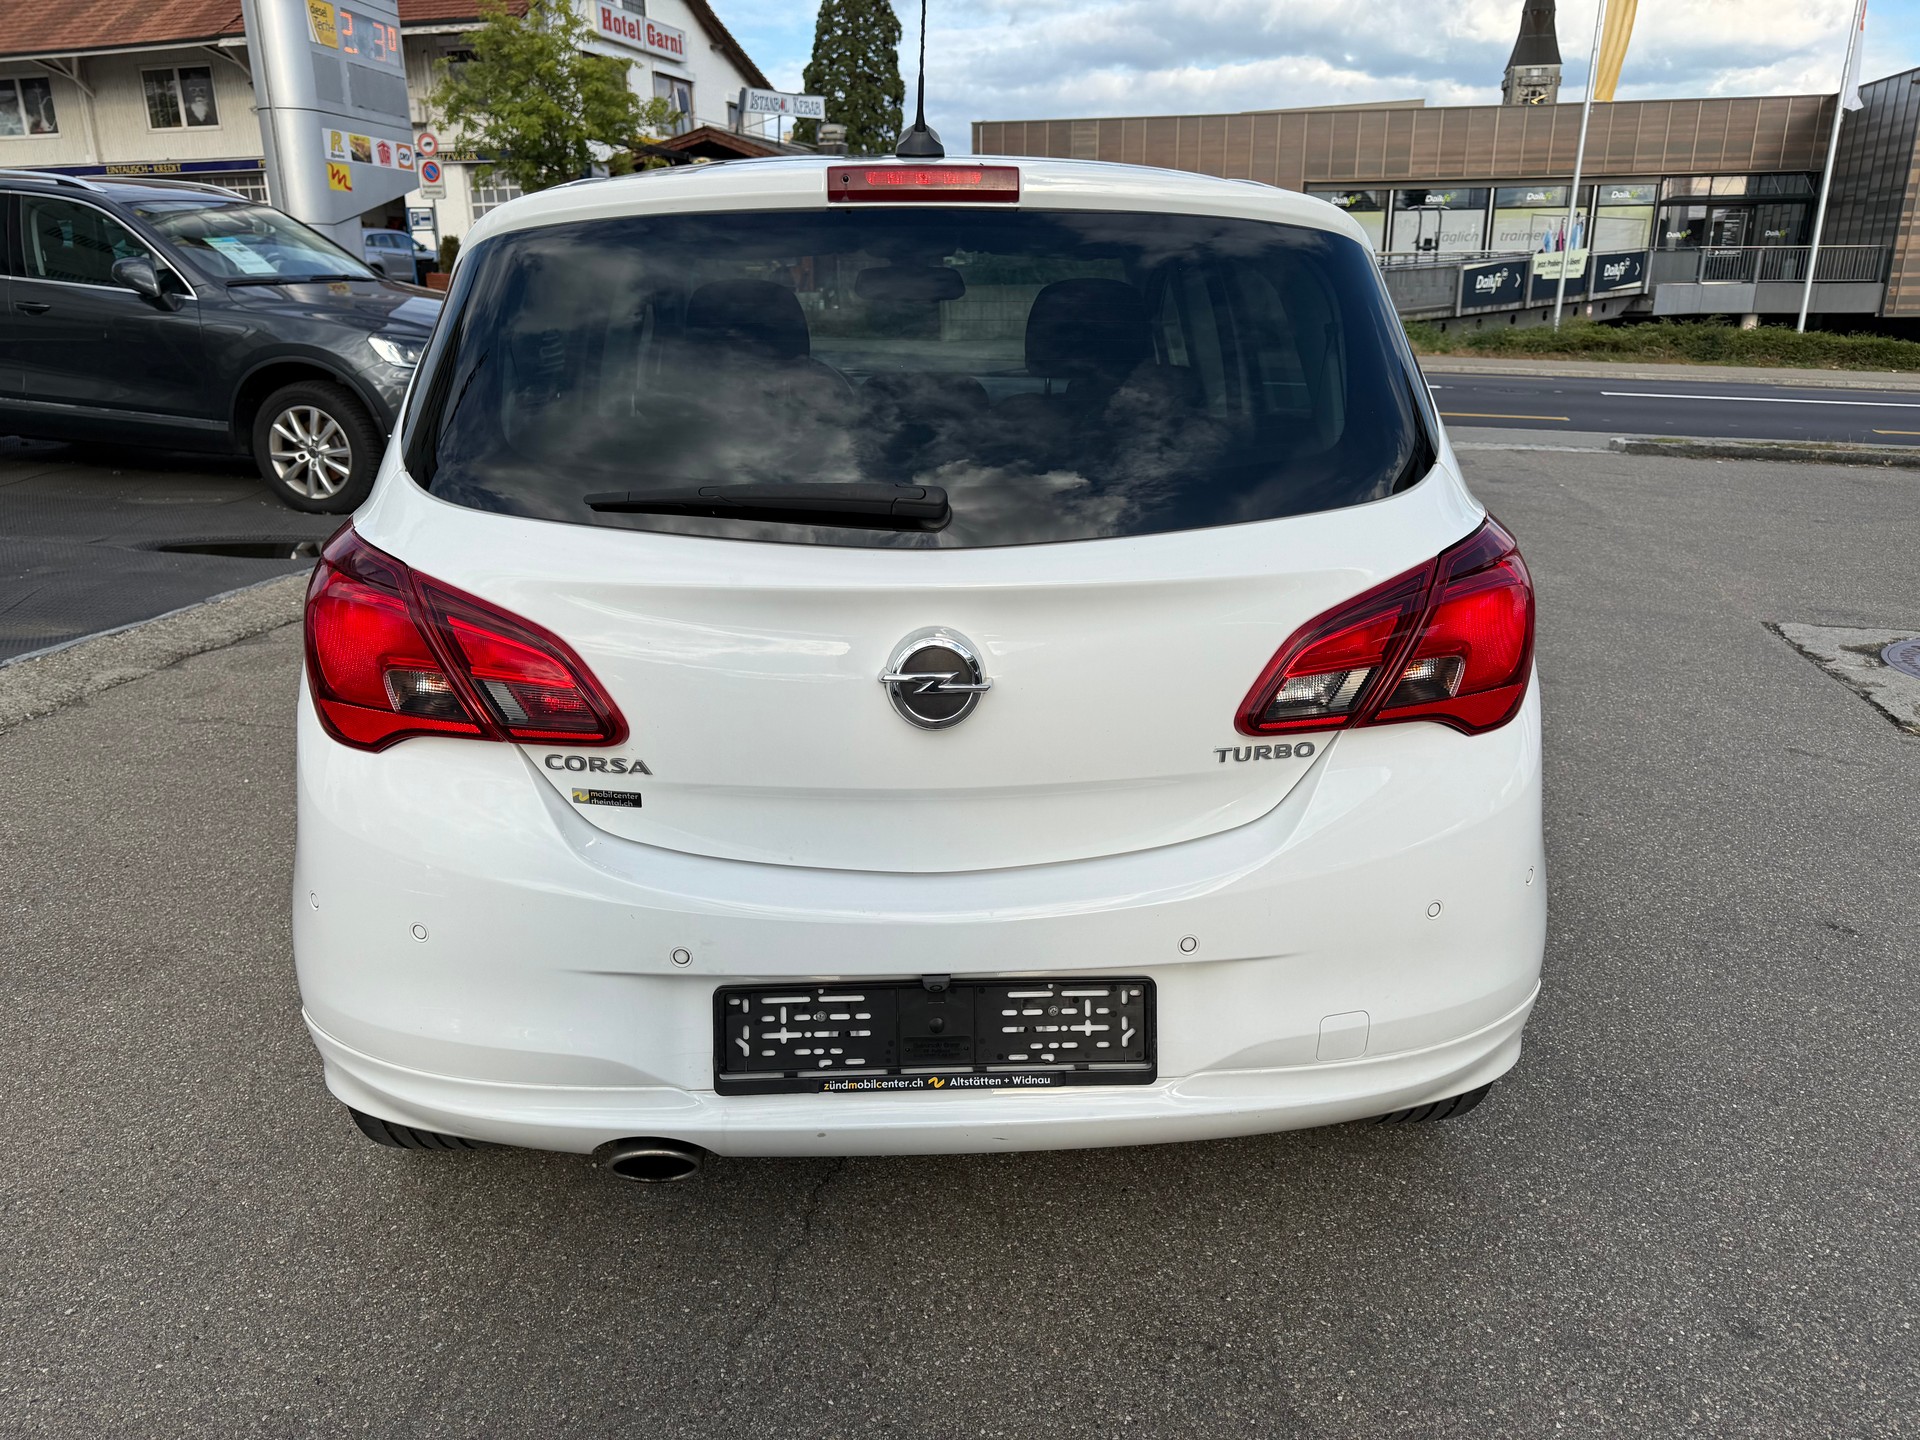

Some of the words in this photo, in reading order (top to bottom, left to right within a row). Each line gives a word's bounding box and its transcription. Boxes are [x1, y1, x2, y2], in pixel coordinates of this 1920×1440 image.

[601, 7, 641, 41] Hotel
[647, 23, 683, 55] Garni
[1213, 741, 1315, 763] TURBO
[544, 754, 653, 776] CORSA
[590, 798, 633, 808] rheintal.ch
[823, 1078, 924, 1091] zündmobilcenter.ch
[950, 1076, 1001, 1087] Altstätten
[1012, 1075, 1051, 1086] Widnau
